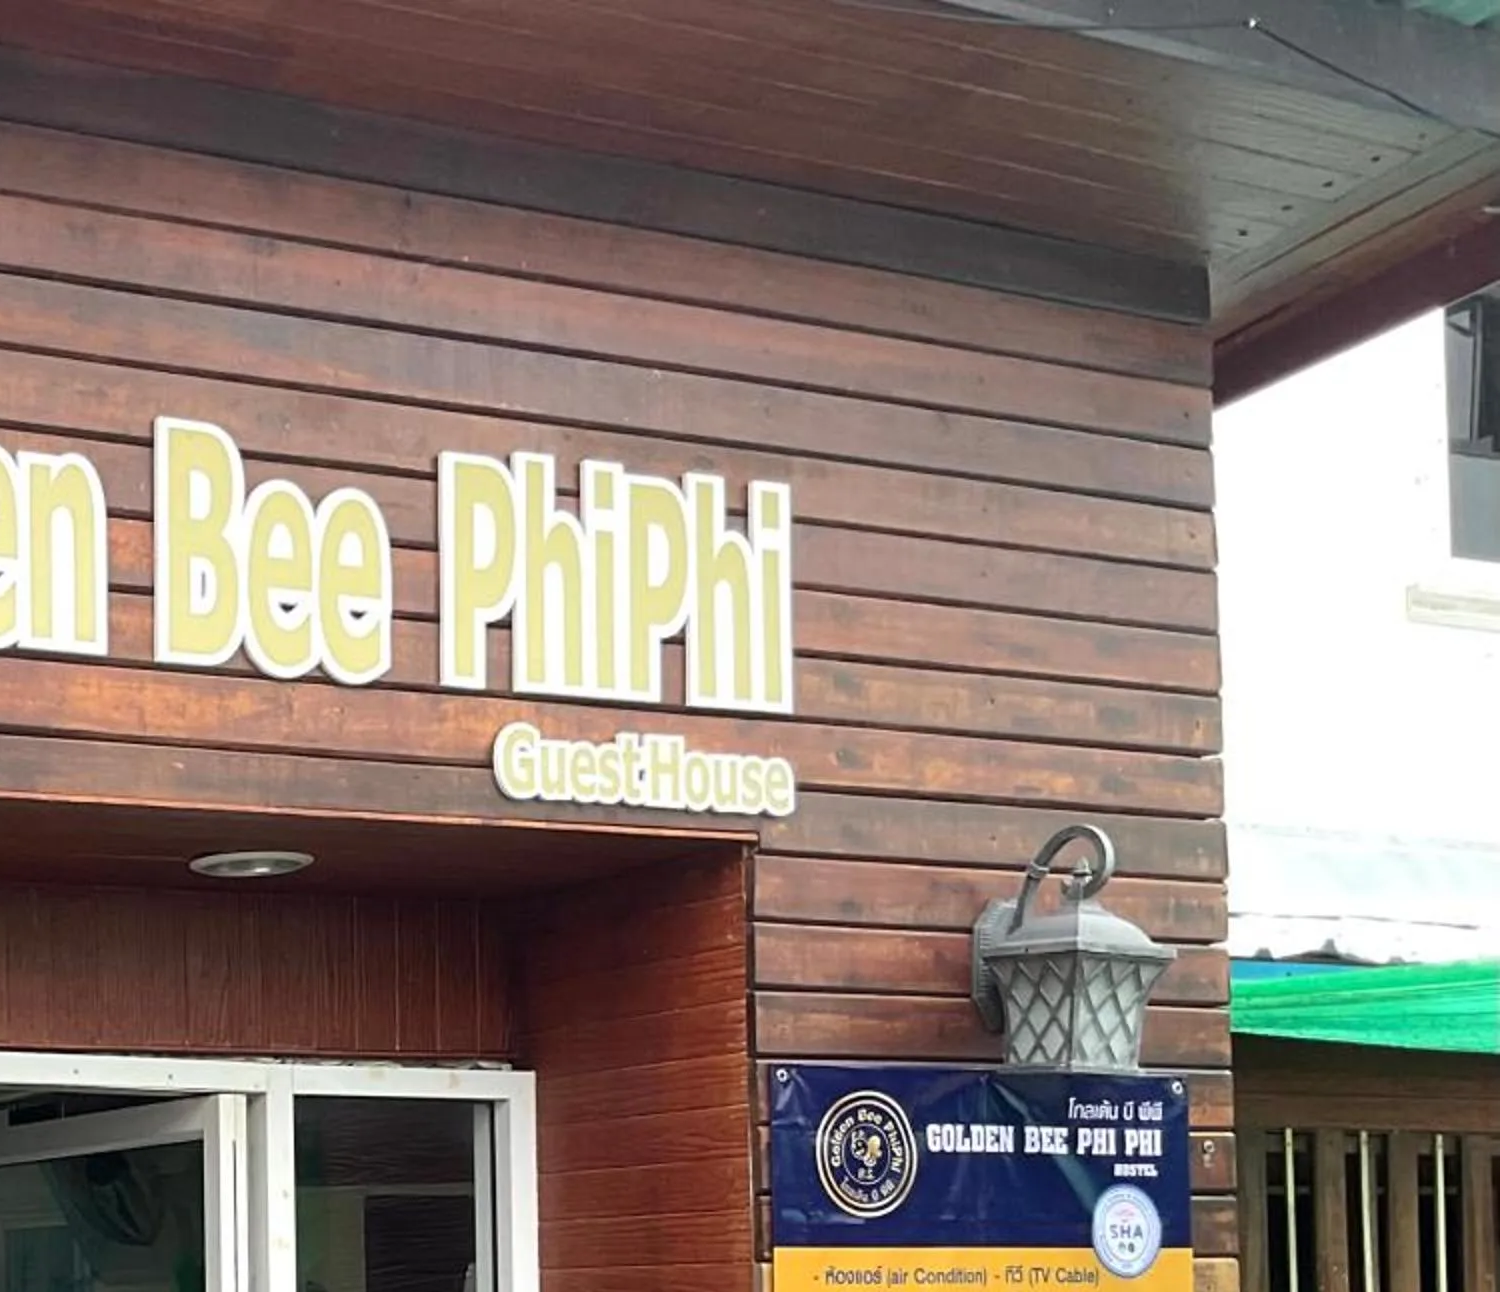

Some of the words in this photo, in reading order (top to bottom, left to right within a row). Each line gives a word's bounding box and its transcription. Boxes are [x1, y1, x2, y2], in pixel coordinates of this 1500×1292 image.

[154, 416, 392, 684] Bee
[438, 451, 792, 714] PhiPhi
[926, 1123, 1014, 1153] GOLDEN
[1024, 1125, 1069, 1155] BEE
[1076, 1126, 1116, 1156] PHI
[1125, 1128, 1163, 1157] PHI
[1109, 1224, 1144, 1239] SHA
[887, 1268, 908, 1288] (air
[914, 1267, 987, 1286] Condition)
[1029, 1267, 1050, 1287] (TV
[1055, 1267, 1099, 1288] Cable)
